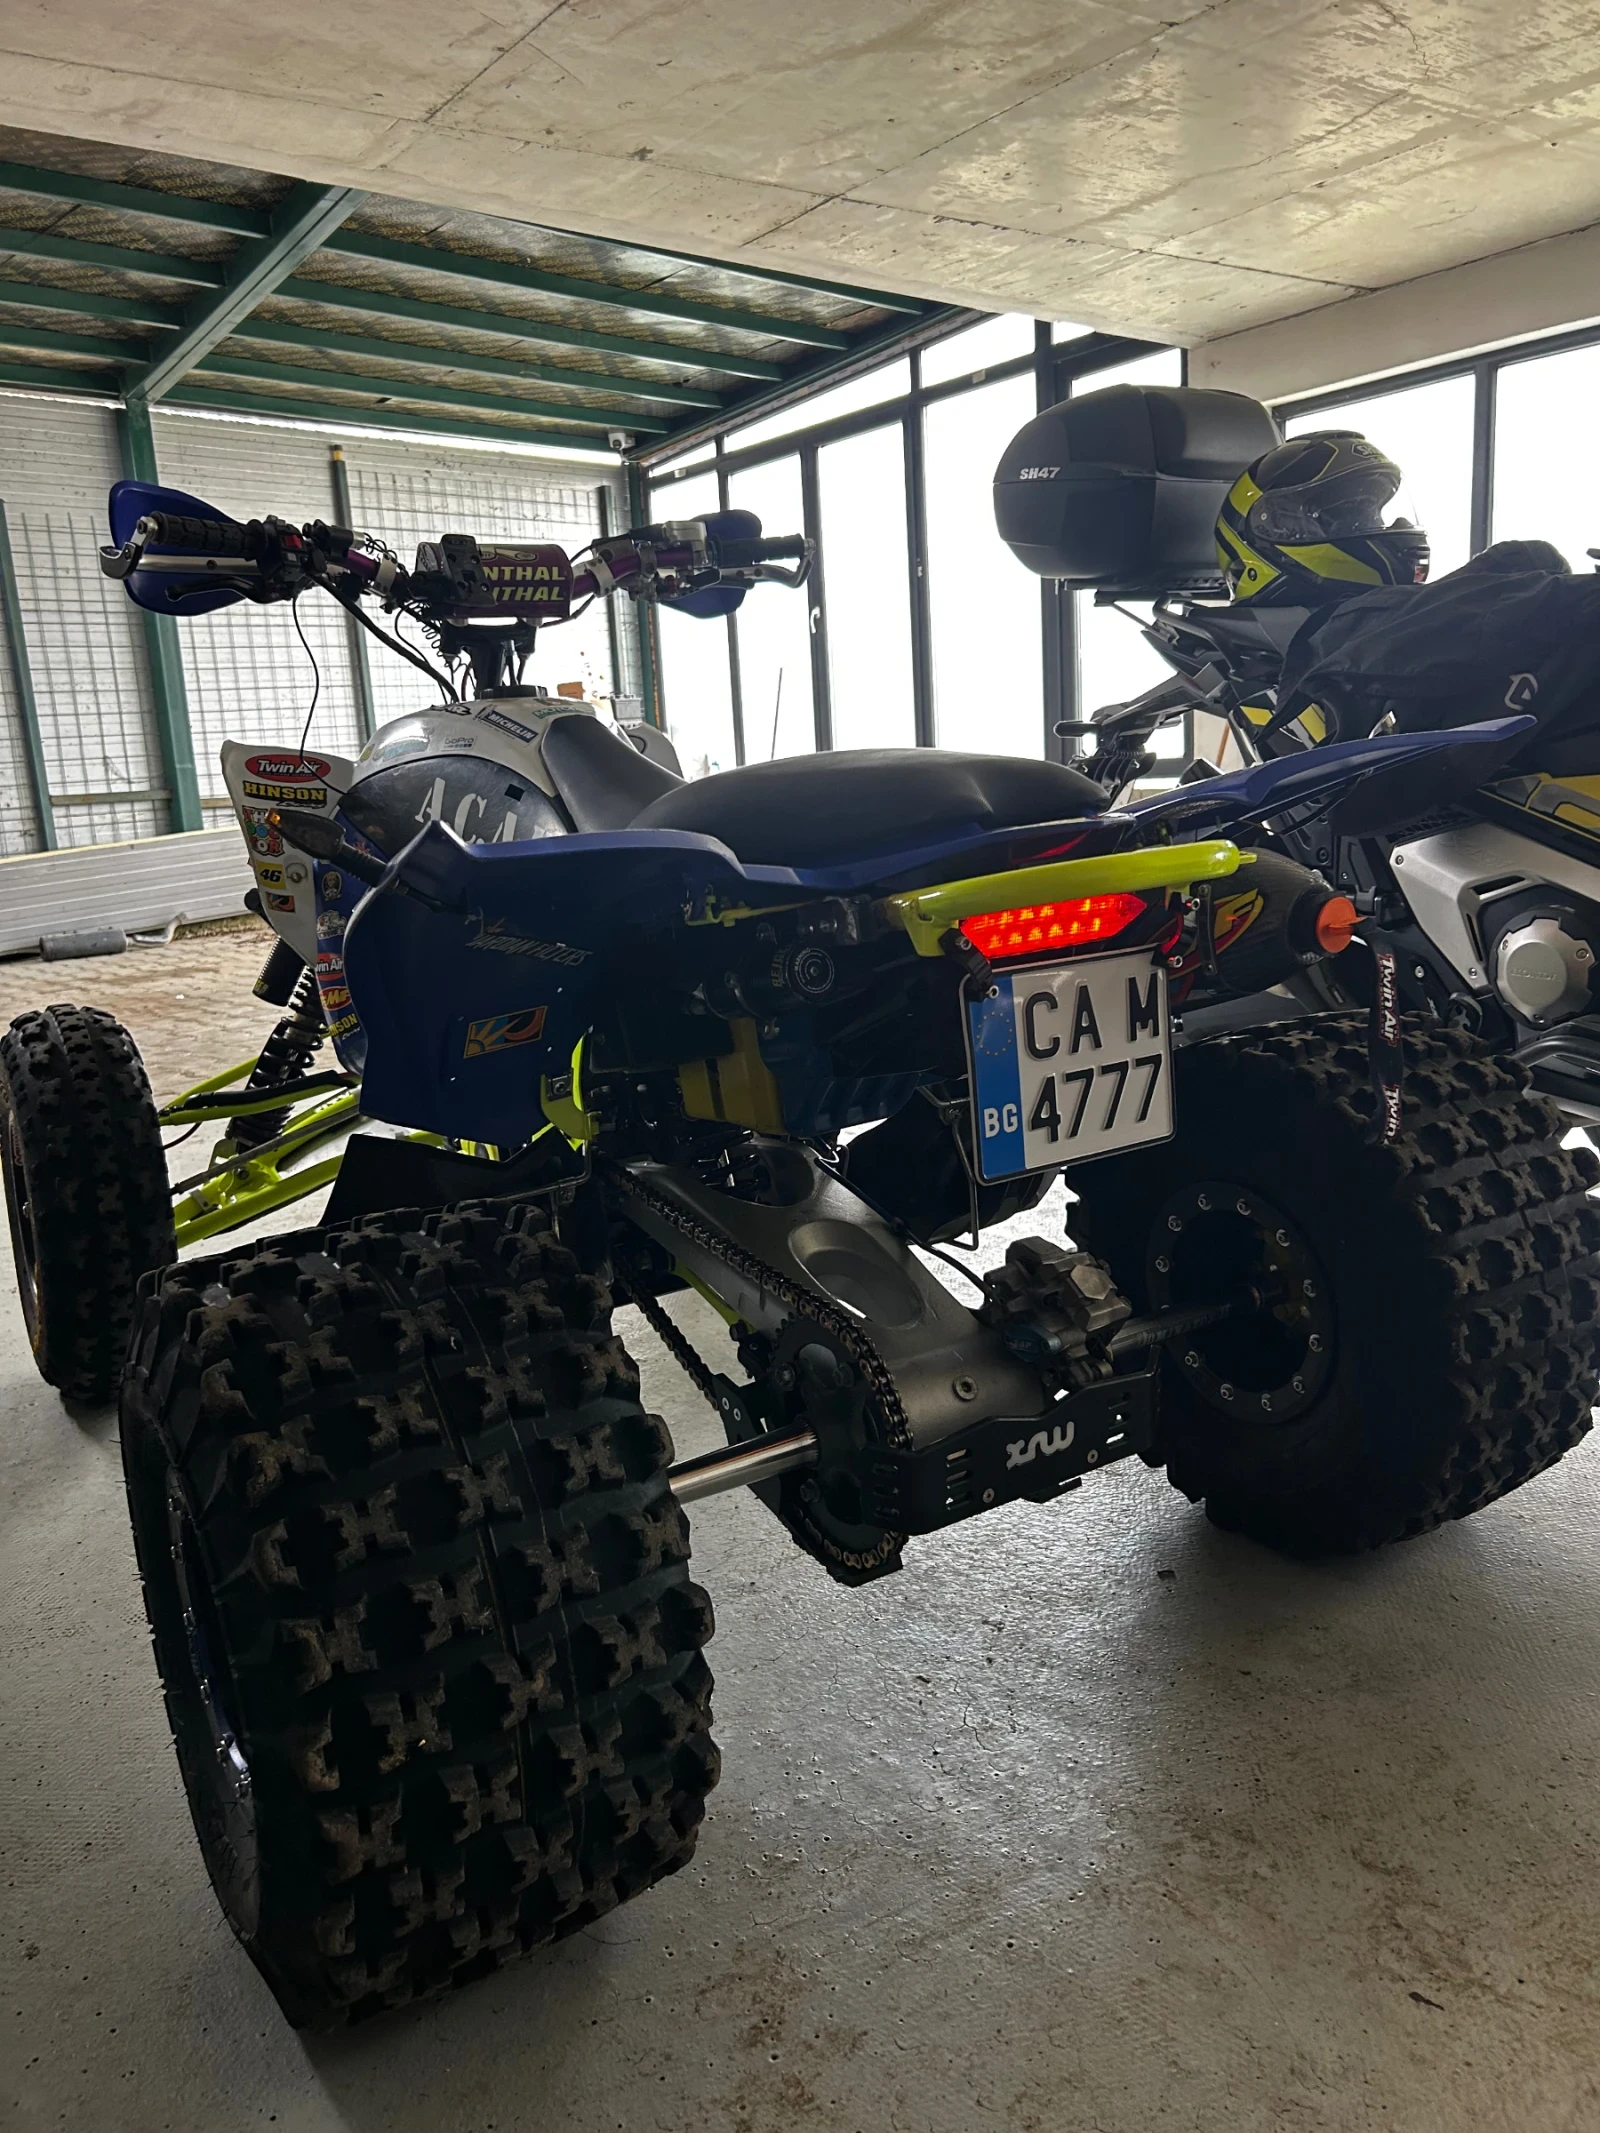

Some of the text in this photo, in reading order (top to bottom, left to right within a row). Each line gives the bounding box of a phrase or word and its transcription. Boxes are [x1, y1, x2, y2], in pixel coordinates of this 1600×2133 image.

[1019, 467, 1061, 480] SH47
[485, 566, 566, 581] NTHAL
[488, 713, 535, 740] MICHELIN
[444, 738, 475, 746] GoPro
[257, 760, 321, 774] Twin Air
[244, 782, 326, 801] HINSON
[260, 868, 283, 883] 46
[1379, 956, 1398, 1042] Twin Air
[1024, 972, 1161, 1060] CA M
[1030, 1053, 1163, 1144] 4777
[983, 1103, 1019, 1138] BG
[1384, 1087, 1400, 1139] Twin
